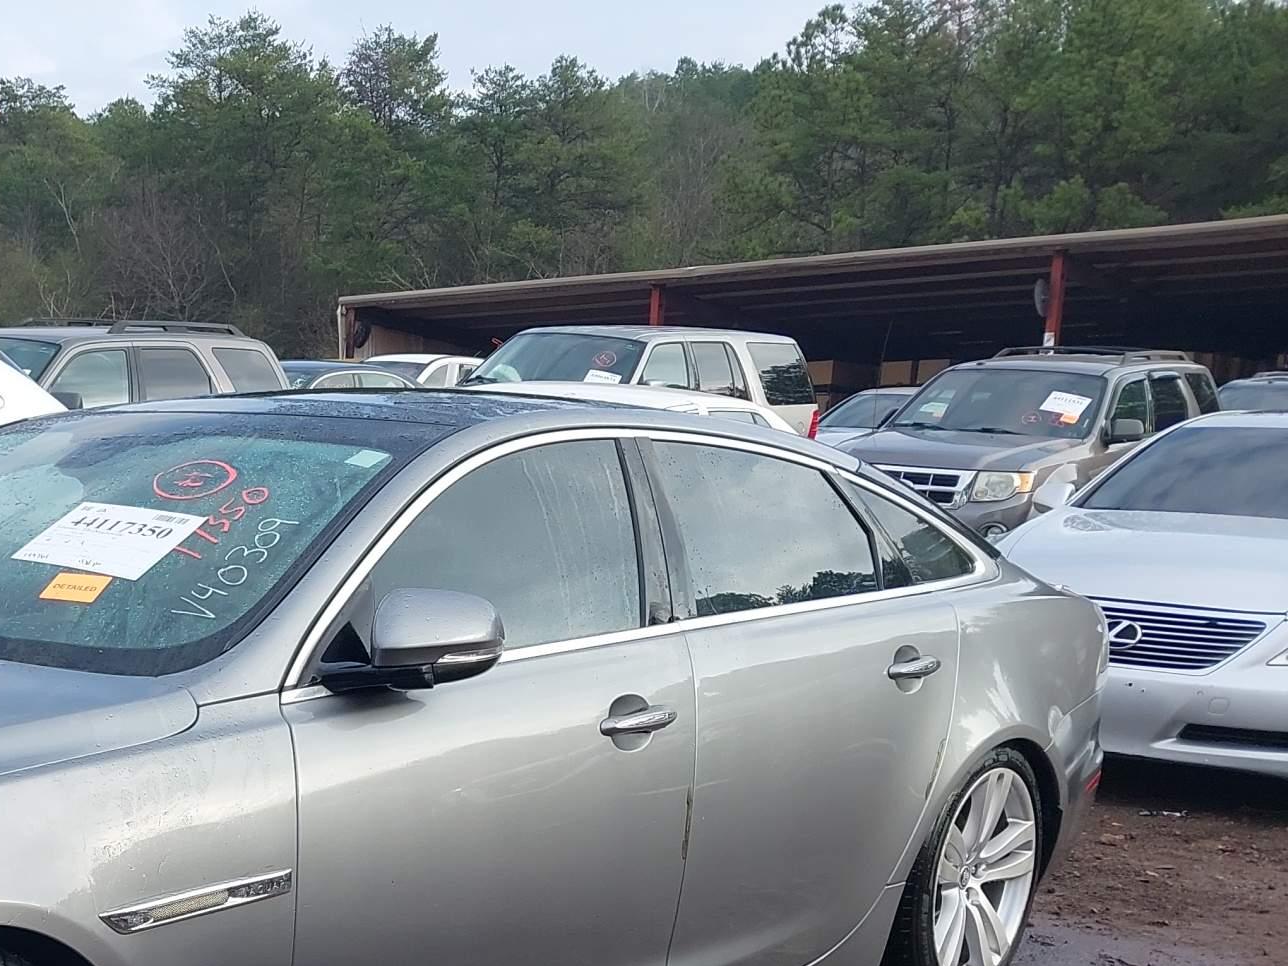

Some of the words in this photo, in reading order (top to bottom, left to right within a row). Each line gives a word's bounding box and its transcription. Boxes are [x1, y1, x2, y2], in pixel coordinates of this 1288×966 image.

[72, 516, 174, 539] 44117350
[171, 518, 300, 618] V40309
[53, 583, 98, 593] DETAILED
